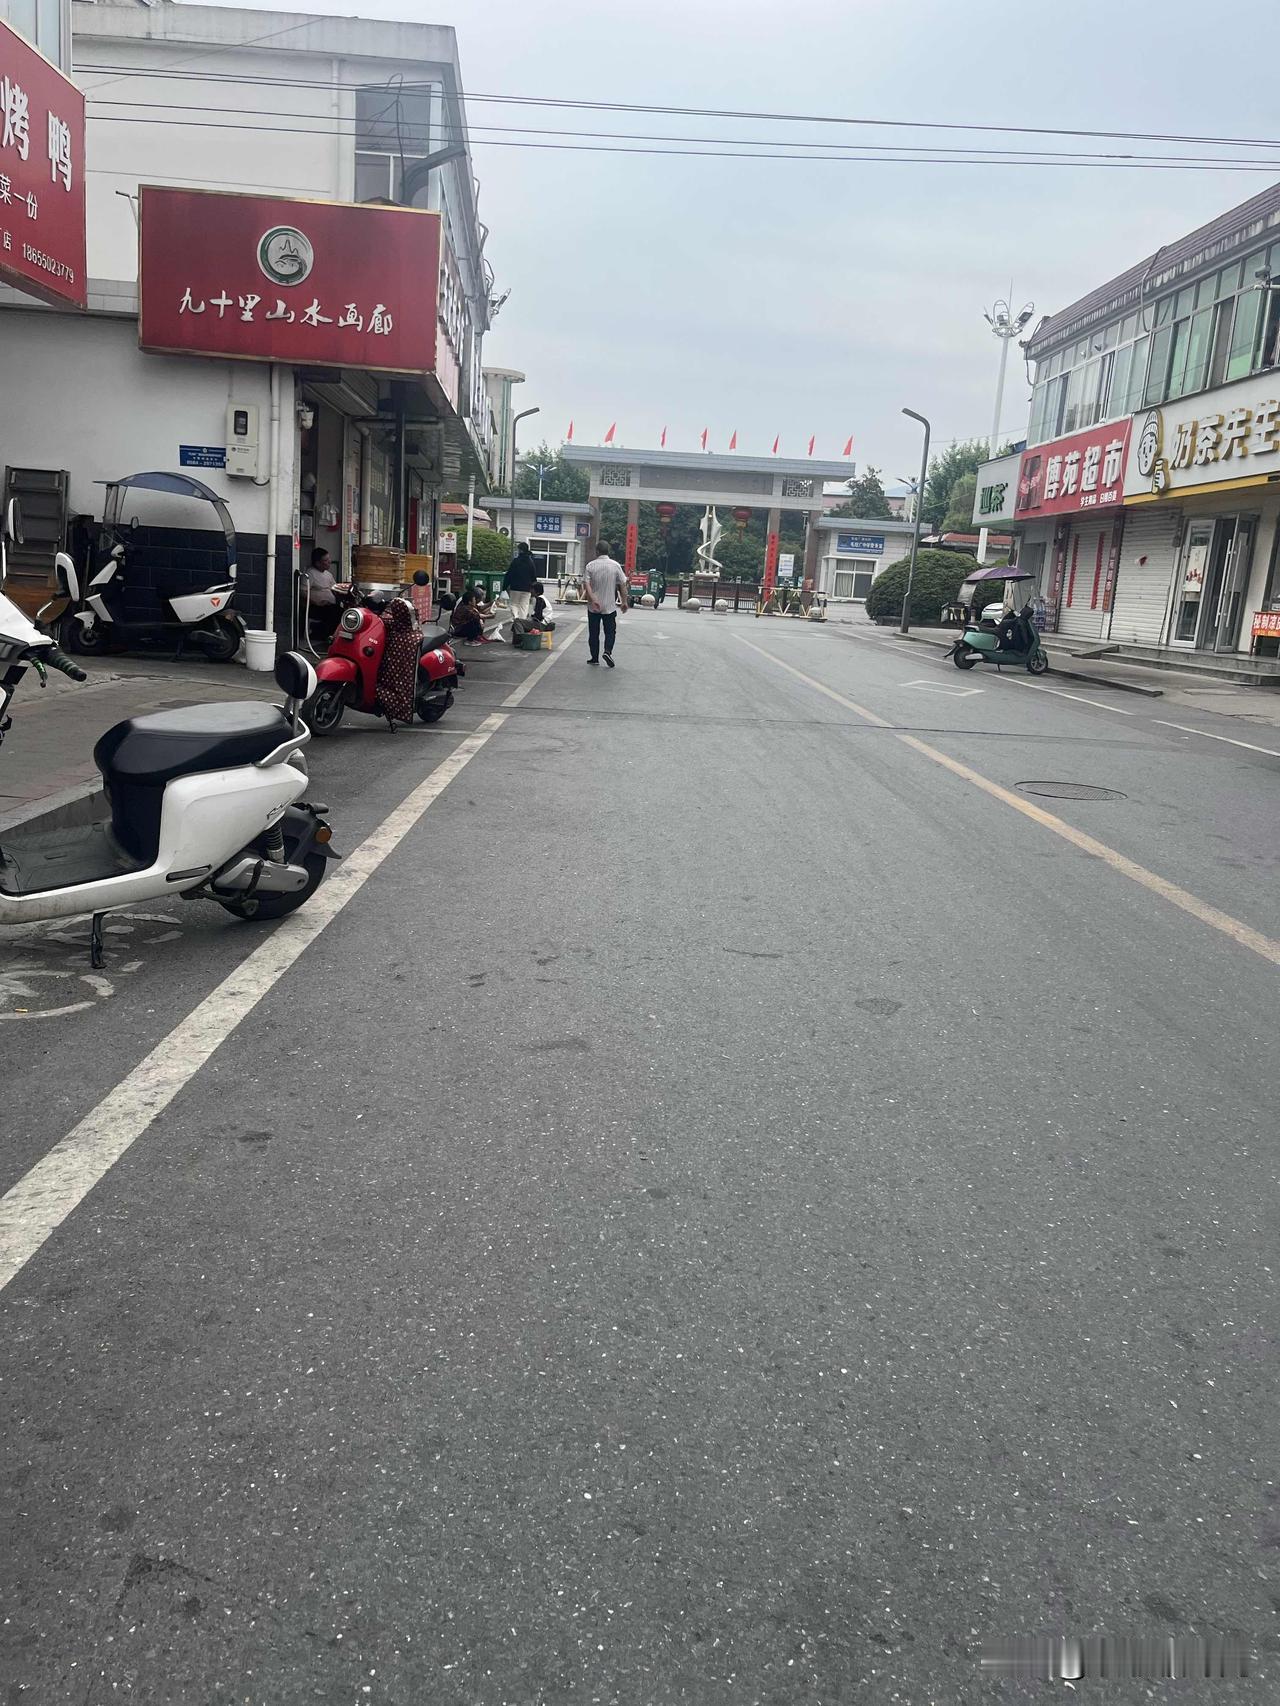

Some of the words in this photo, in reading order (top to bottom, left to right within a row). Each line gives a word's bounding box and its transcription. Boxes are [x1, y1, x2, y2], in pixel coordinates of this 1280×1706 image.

[0, 75, 72, 192] 烤鸭
[0, 173, 38, 220] 菜一份
[22, 242, 74, 284] 18655023779
[179, 287, 393, 336] 九十里山水画廊
[1170, 399, 1280, 470] 奶茶先生
[1043, 438, 1123, 500] 博苑超市
